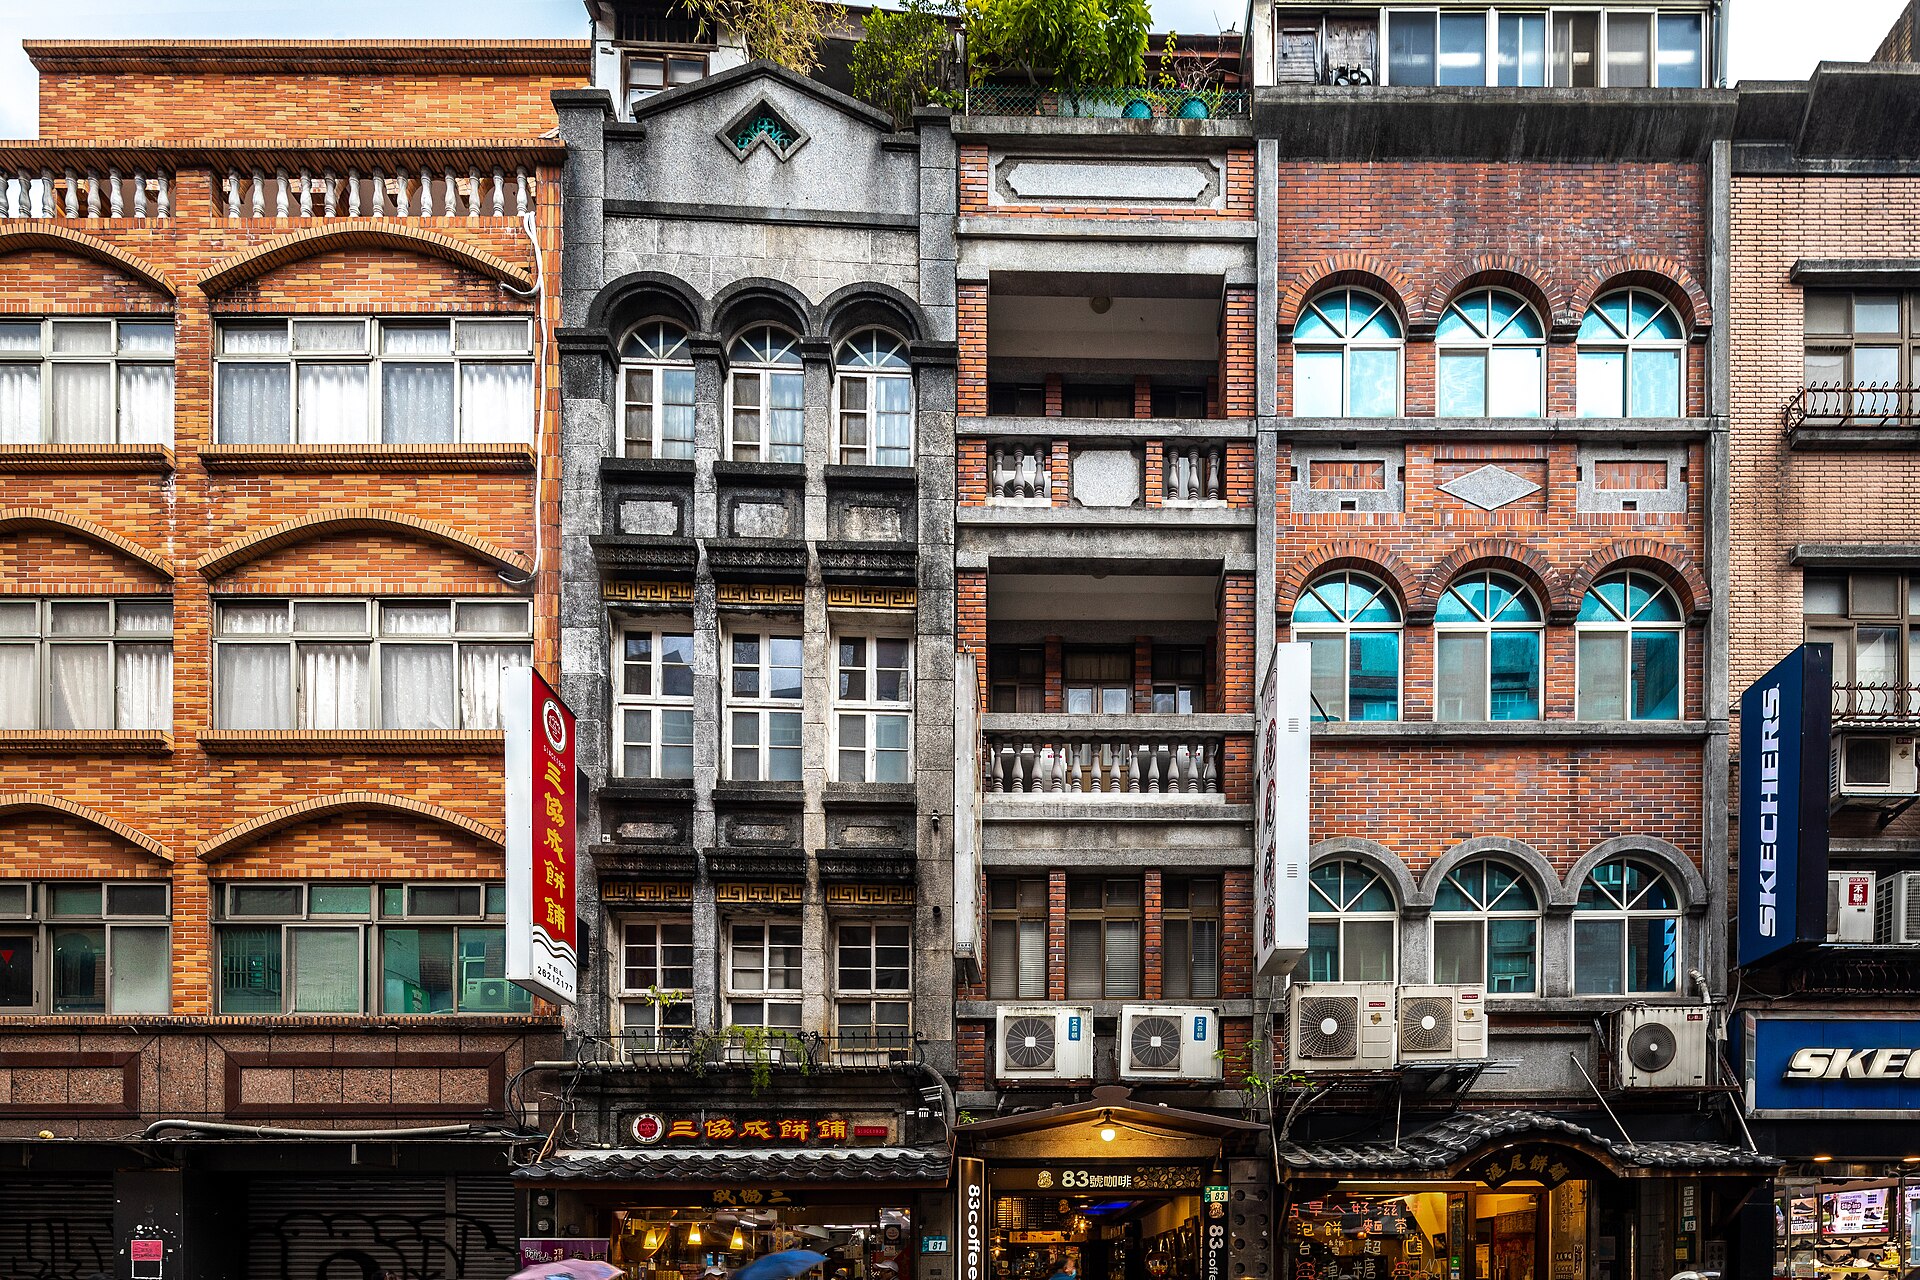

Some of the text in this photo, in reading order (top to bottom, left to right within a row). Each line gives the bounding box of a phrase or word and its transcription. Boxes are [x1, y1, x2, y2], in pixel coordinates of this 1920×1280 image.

[1759, 684, 1780, 937] SKECHERS
[537, 965, 574, 993] 26212177
[546, 962, 564, 978] TEL
[1061, 1170, 1132, 1188] 83號咖啡
[1214, 1192, 1225, 1200] 83
[932, 1241, 943, 1250] 81
[1363, 1238, 1382, 1256] 超
